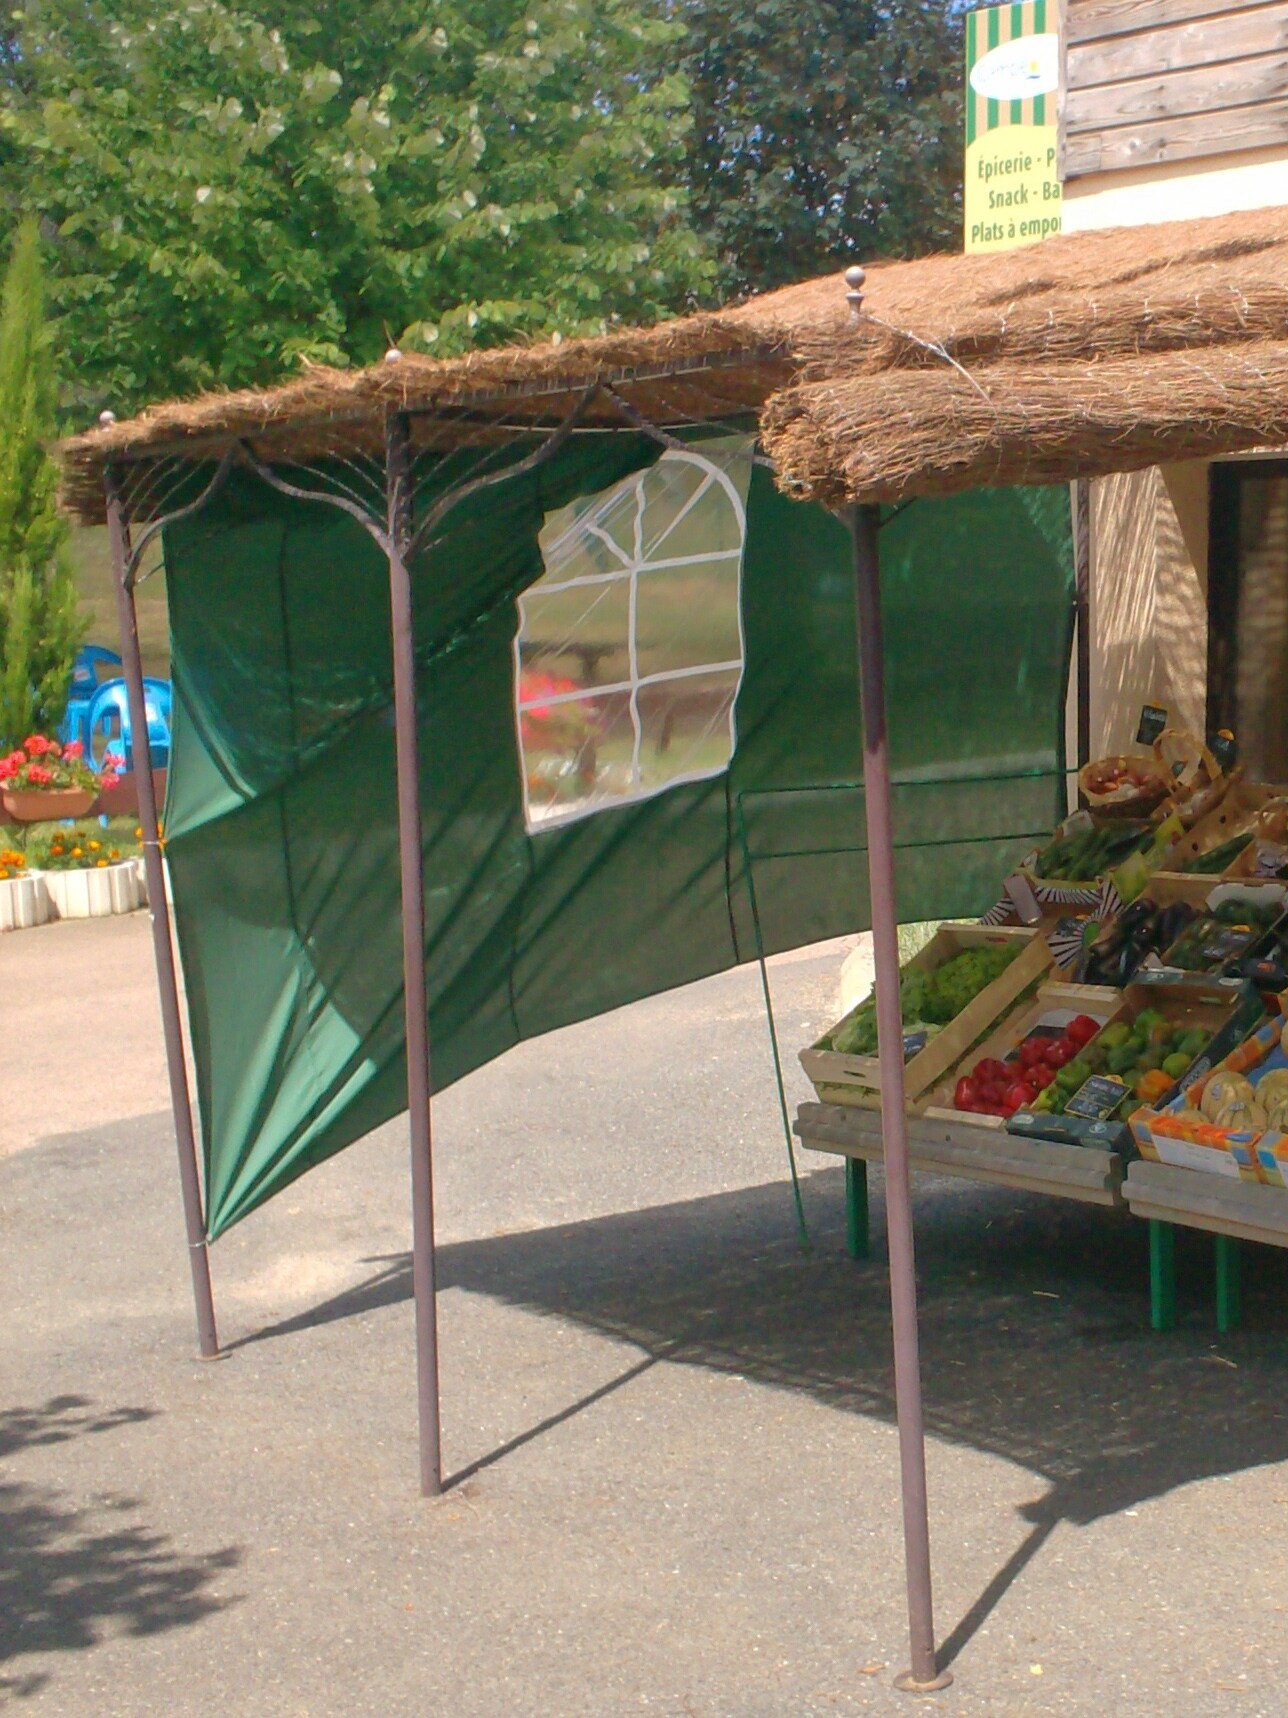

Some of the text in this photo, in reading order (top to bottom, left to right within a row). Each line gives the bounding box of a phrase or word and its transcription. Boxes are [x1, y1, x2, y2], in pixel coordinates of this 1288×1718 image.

[978, 151, 1032, 183] Épicerie
[988, 183, 1028, 209] Snack
[972, 221, 1004, 243] Plats
